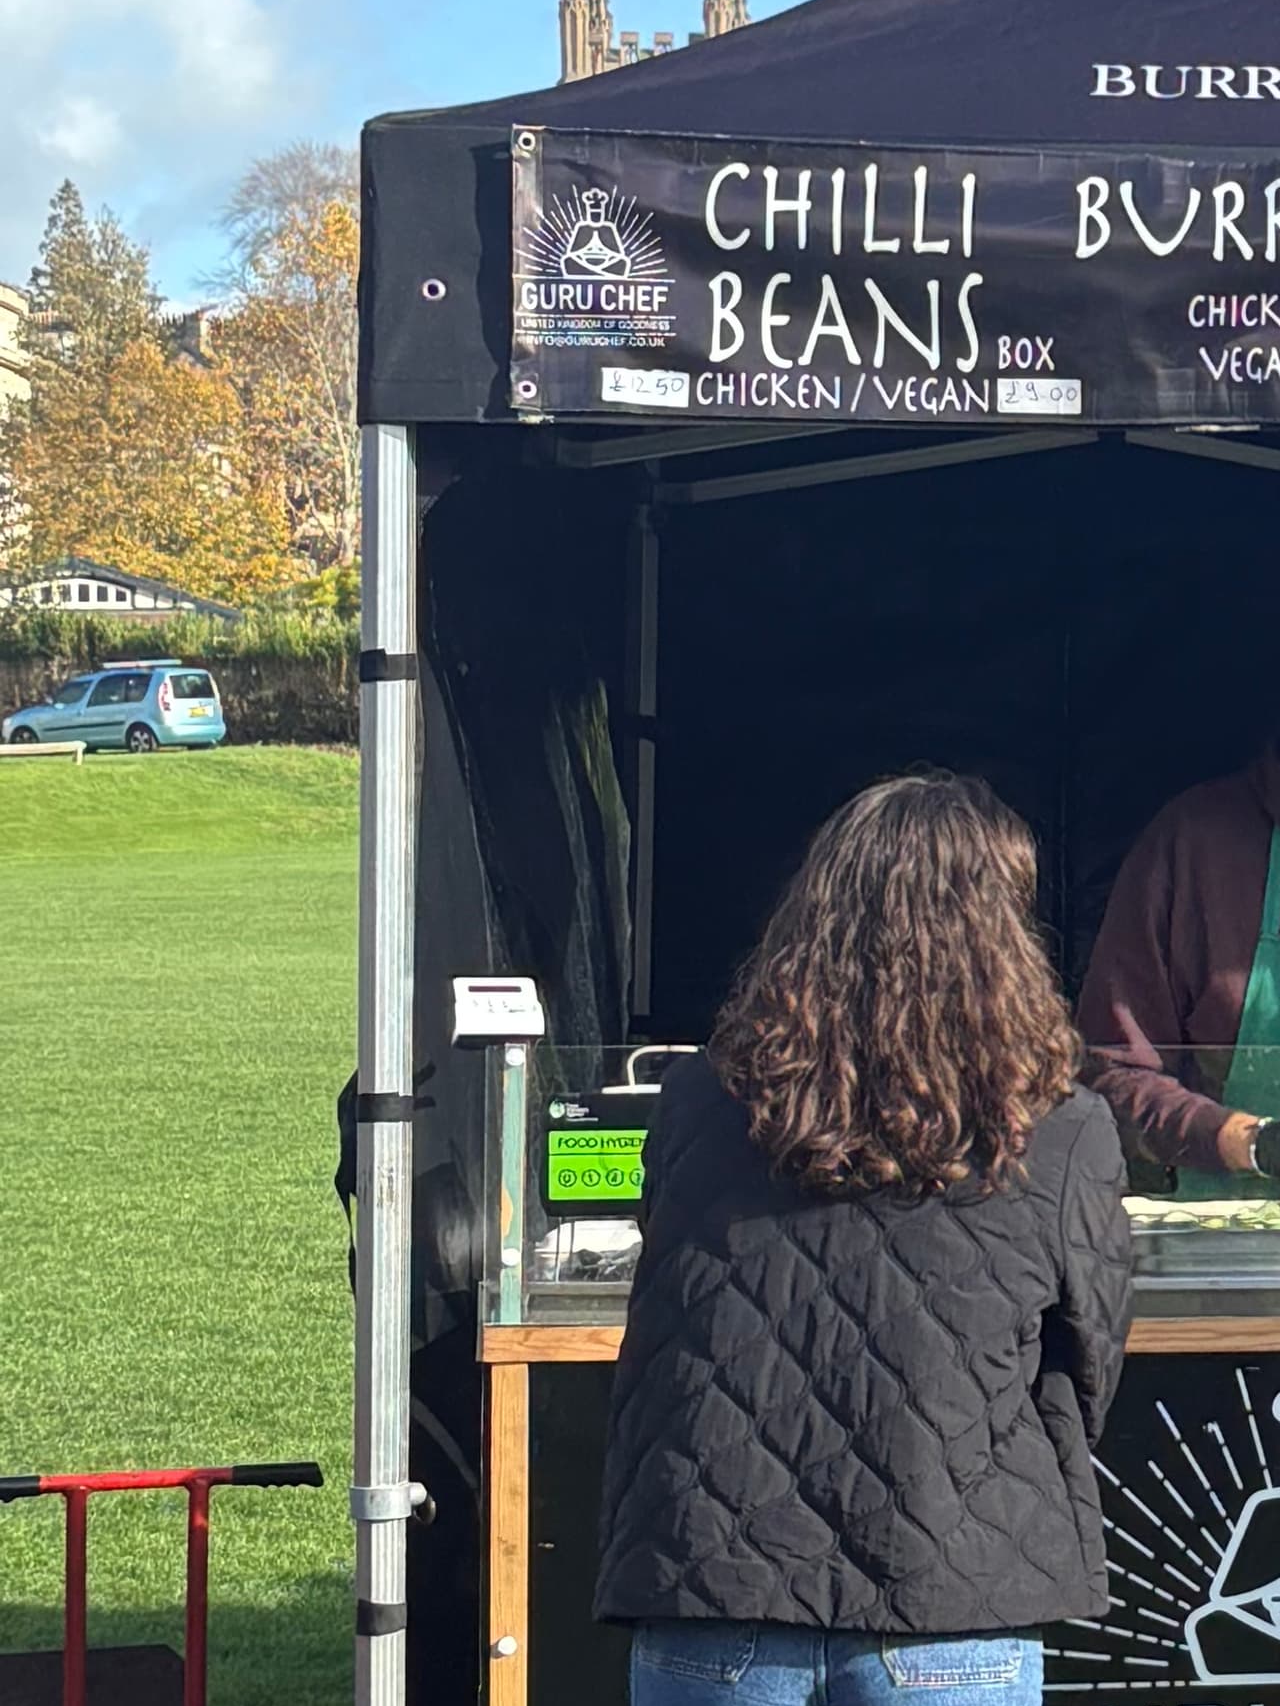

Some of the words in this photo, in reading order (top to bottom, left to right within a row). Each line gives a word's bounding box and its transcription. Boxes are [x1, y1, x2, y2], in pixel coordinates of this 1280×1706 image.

[706, 162, 976, 258] CHILLI
[520, 282, 593, 310] GURU
[600, 284, 669, 312] CHEF
[708, 270, 983, 371] BEANS
[998, 336, 1055, 371] BOX
[697, 372, 842, 408] CHICKEN
[873, 376, 990, 414] VEGAN
